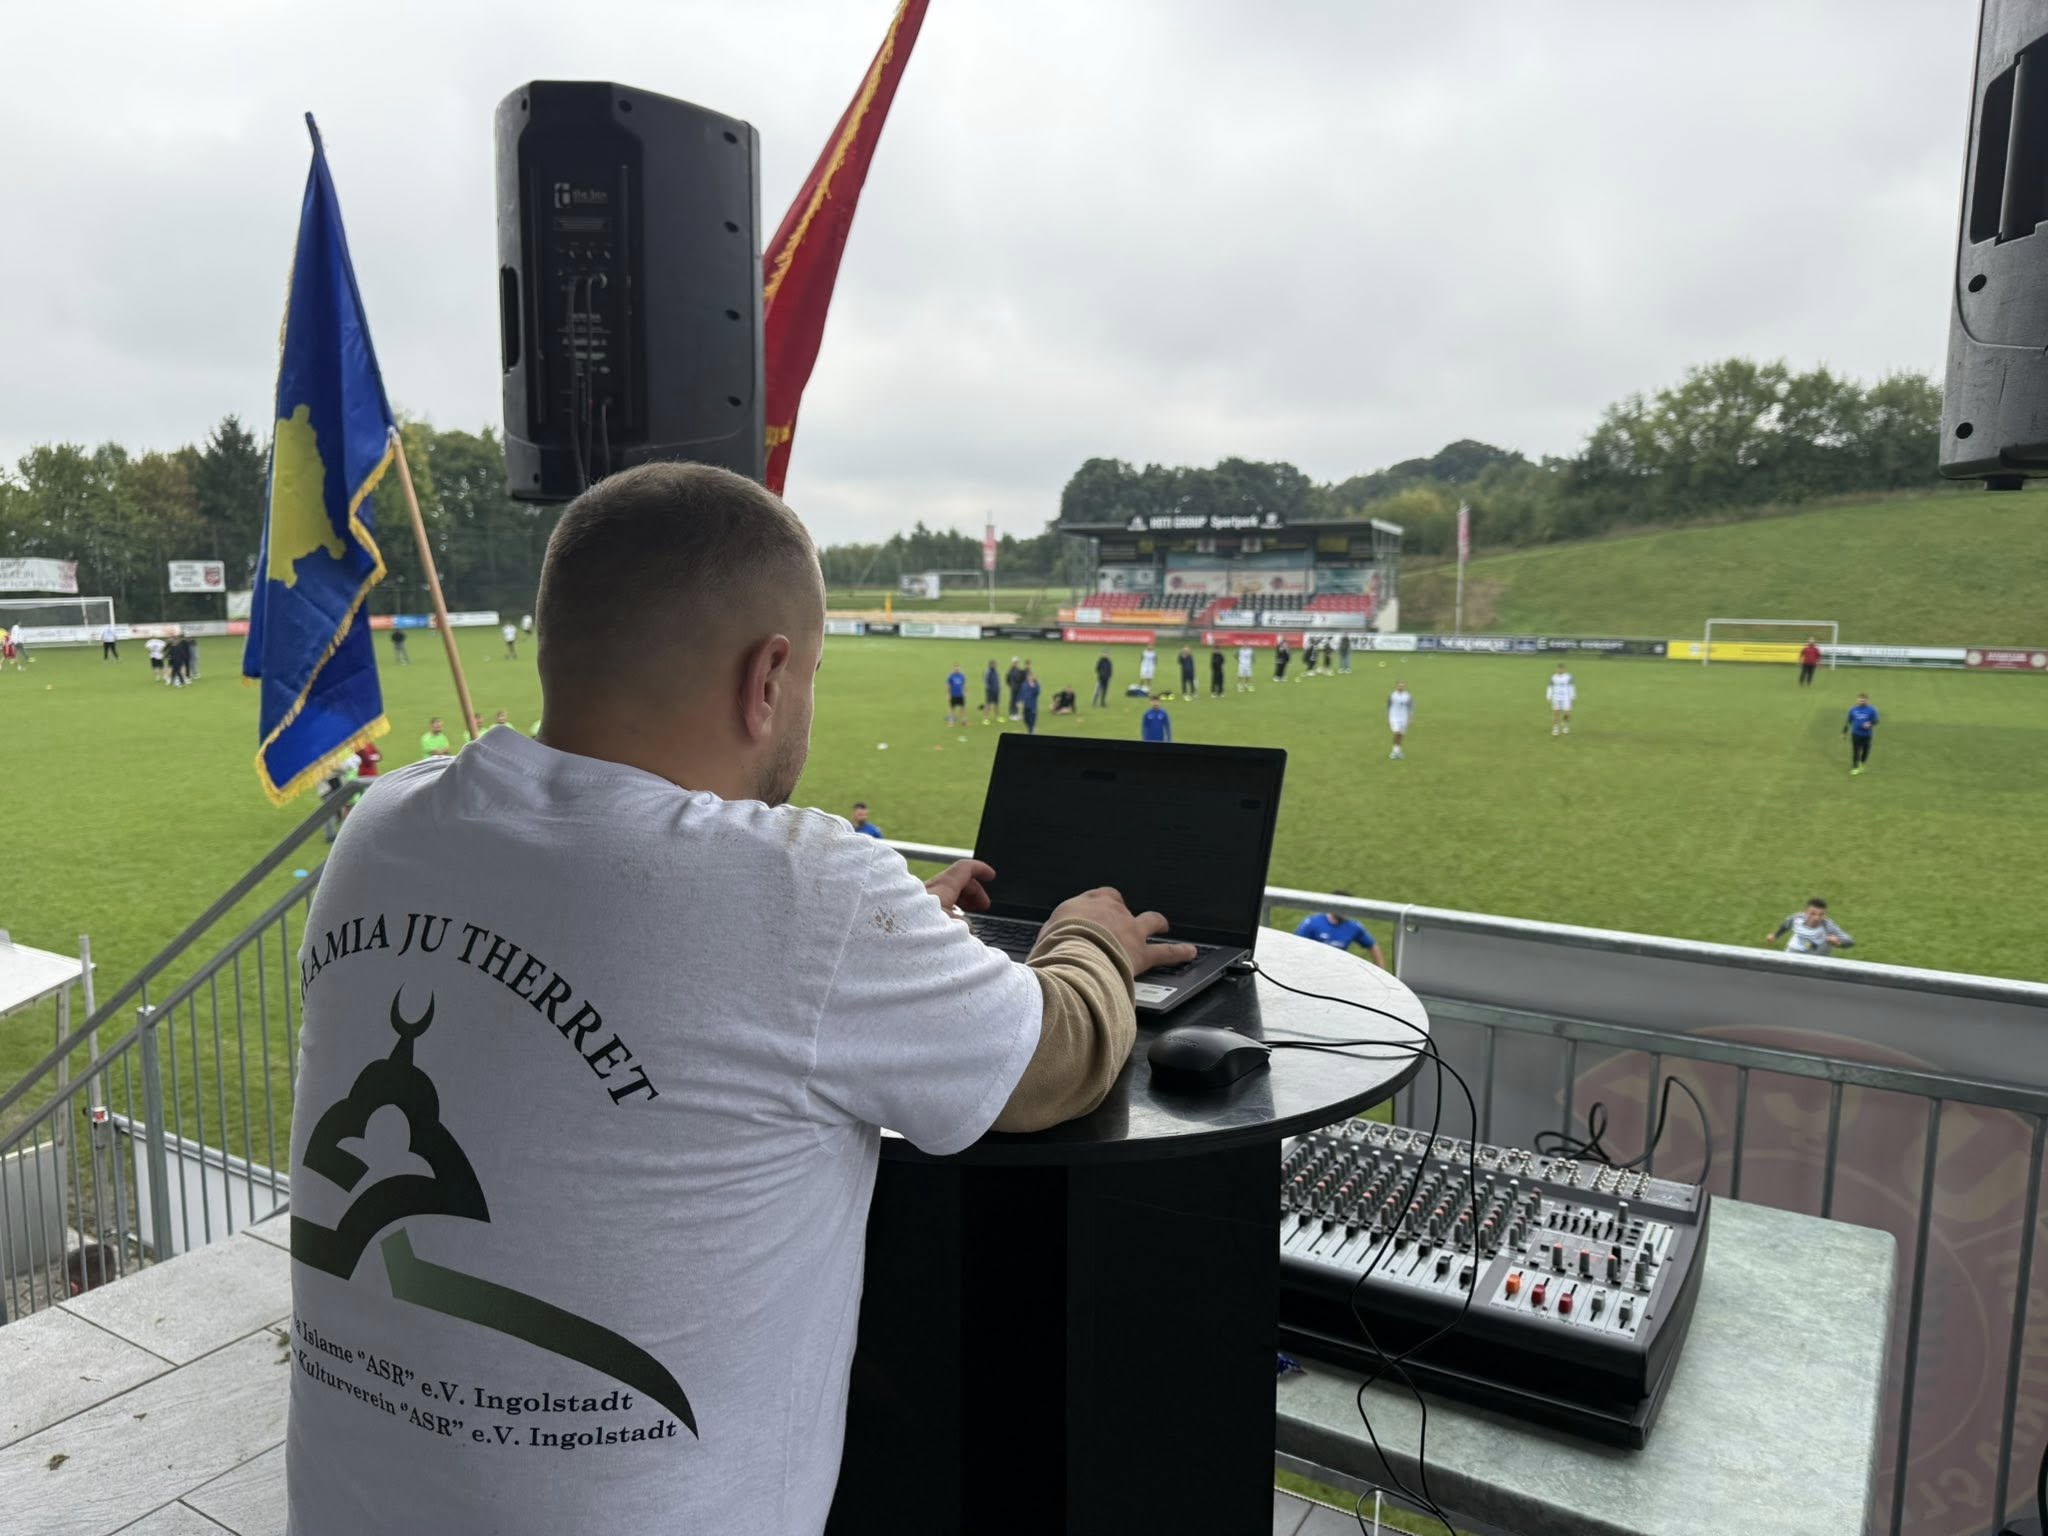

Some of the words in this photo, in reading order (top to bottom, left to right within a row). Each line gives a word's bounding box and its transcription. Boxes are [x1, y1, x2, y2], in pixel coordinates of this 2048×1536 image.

[397, 912, 453, 957] JU
[456, 921, 660, 1106] THERRET
[298, 1348, 396, 1416] Kulturverein
[471, 1425, 520, 1446] e.V.
[528, 1419, 678, 1451] Ingolstadt
[302, 1321, 354, 1364] Islame
[421, 1380, 465, 1405] e.V.
[474, 1387, 634, 1416] Ingolstadt
